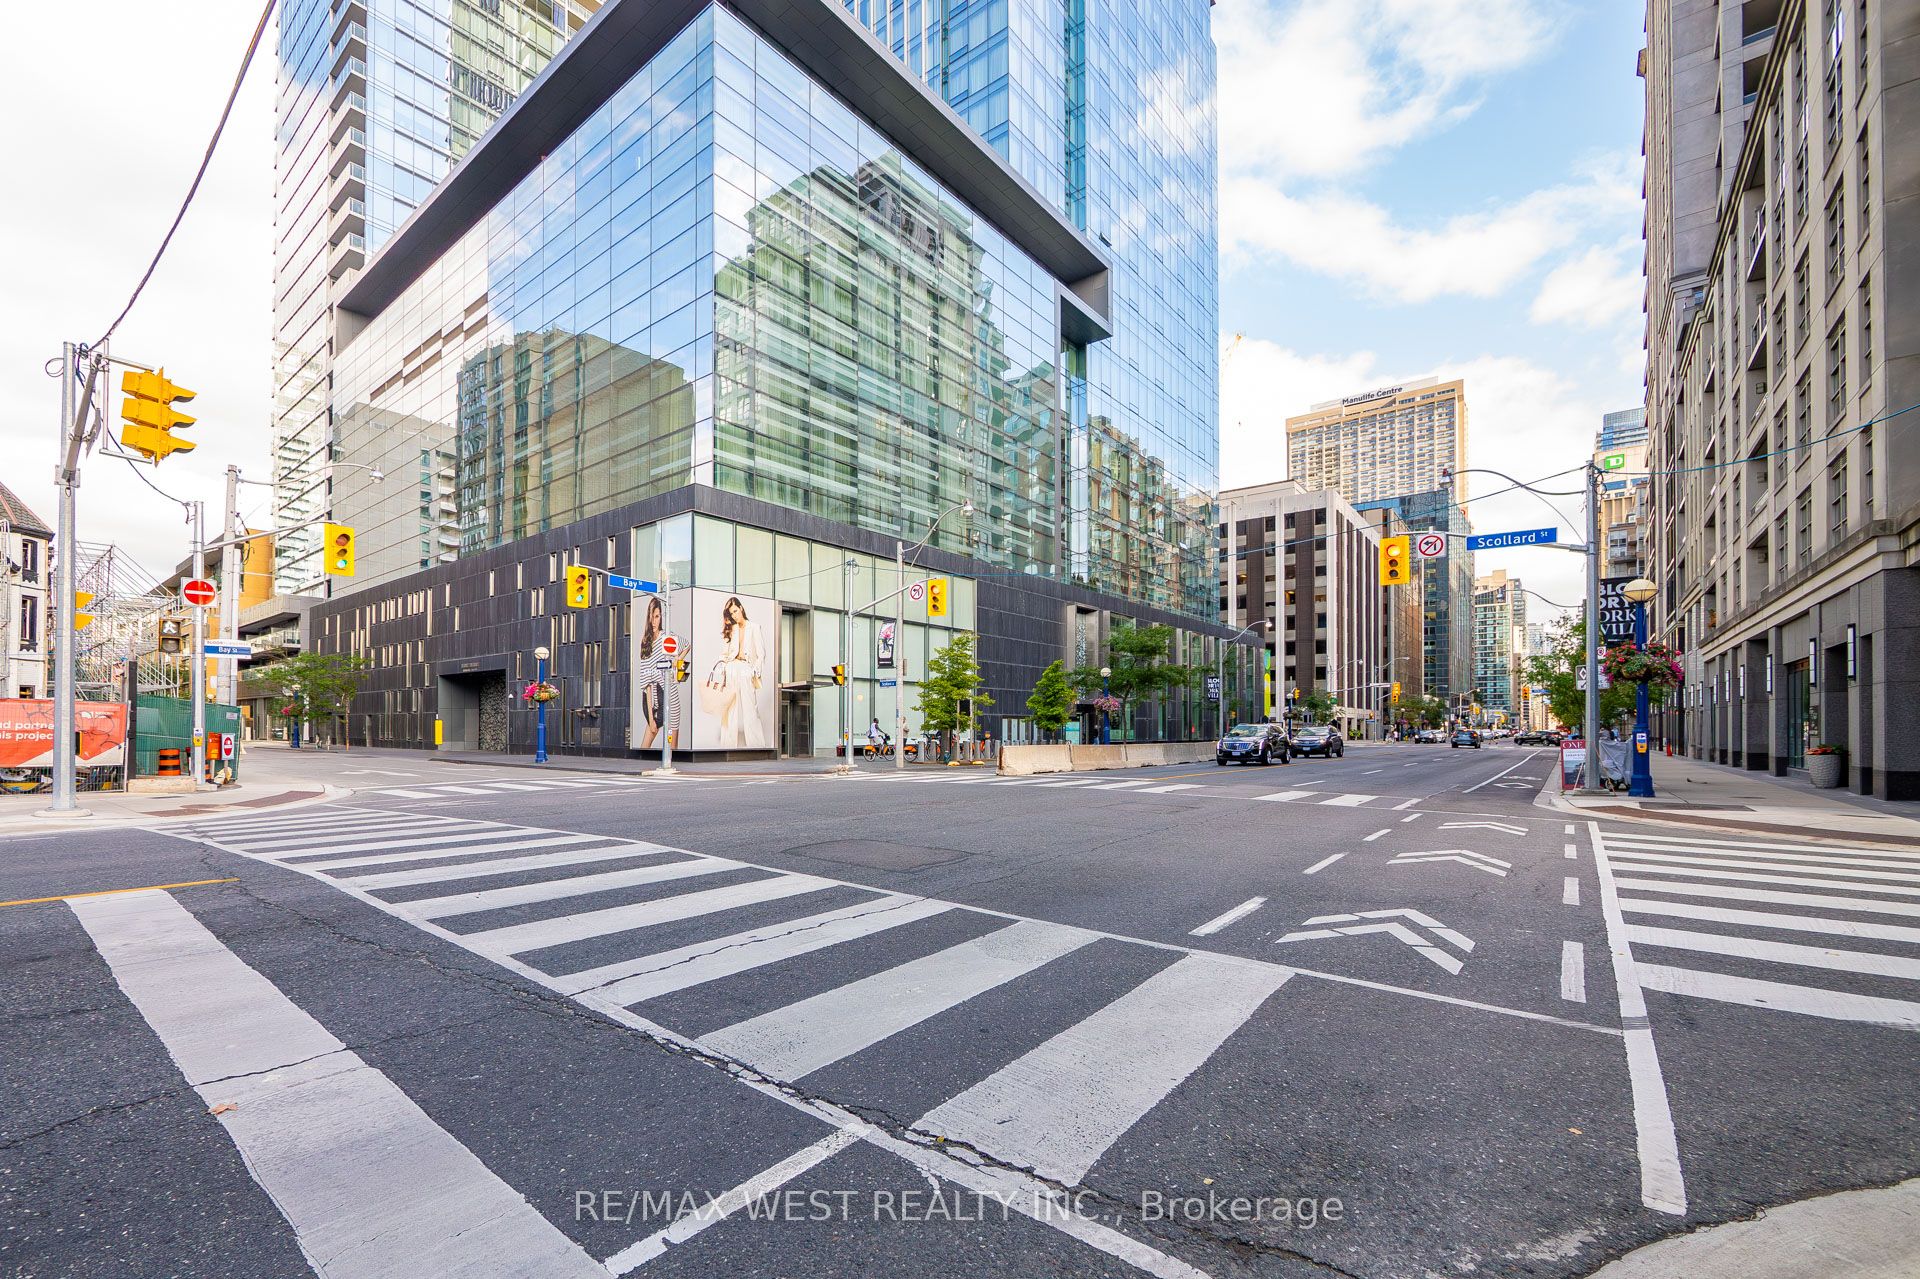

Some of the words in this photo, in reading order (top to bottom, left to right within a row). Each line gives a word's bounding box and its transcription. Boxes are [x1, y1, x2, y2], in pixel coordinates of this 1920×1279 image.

[1342, 393, 1375, 405] Manulife
[1376, 387, 1403, 398] Centre
[1605, 456, 1623, 467] TD
[1477, 532, 1536, 548] Scollard
[623, 578, 638, 590] Bay
[1600, 622, 1636, 635] VILL
[218, 646, 230, 654] Bay
[15, 721, 54, 731] partne
[16, 731, 54, 741] projec
